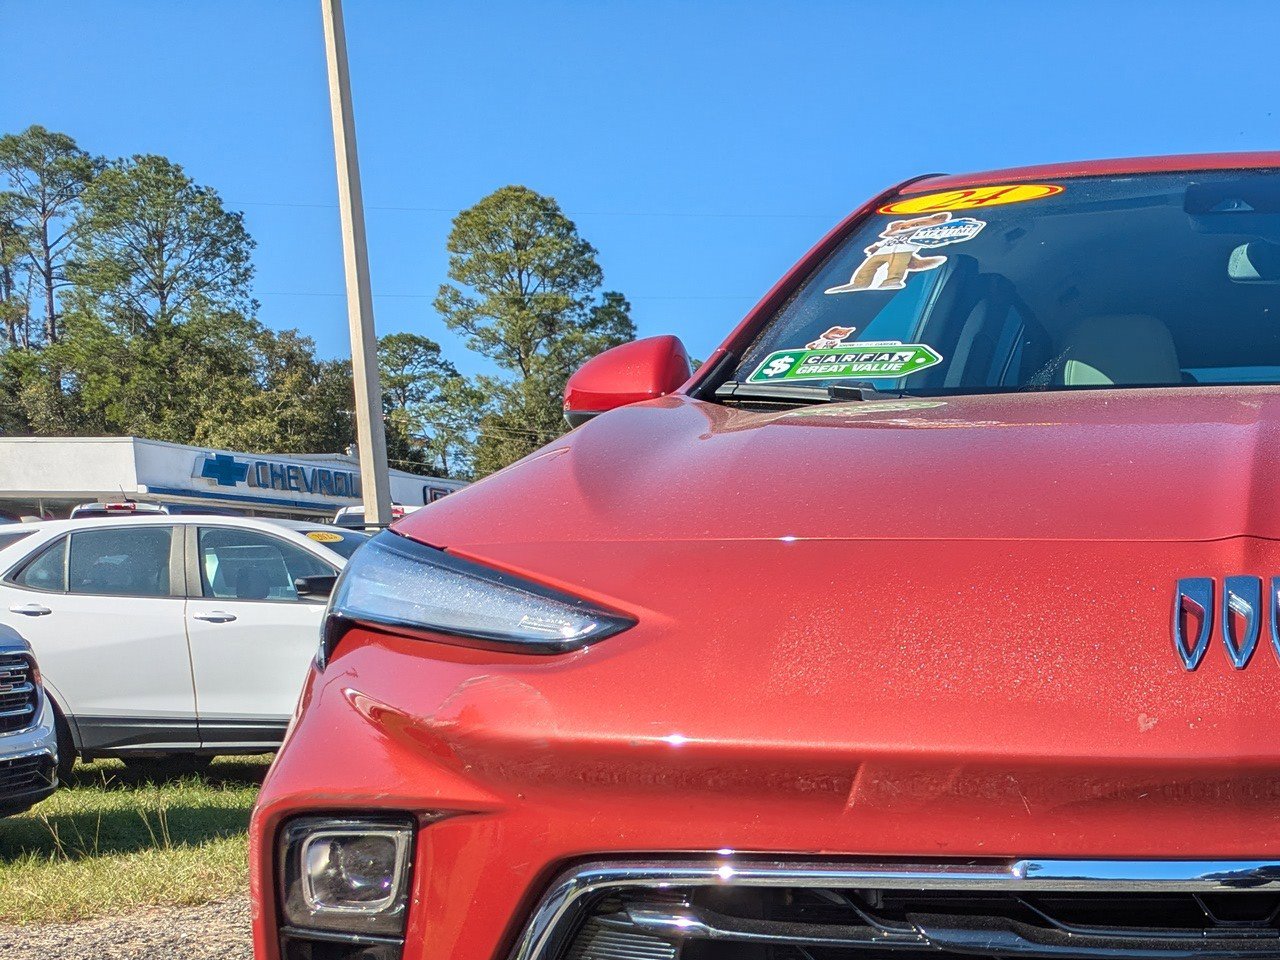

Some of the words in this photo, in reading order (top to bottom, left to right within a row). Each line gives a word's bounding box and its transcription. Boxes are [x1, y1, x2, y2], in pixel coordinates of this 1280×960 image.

[763, 355, 795, 377] $
[806, 352, 913, 364] CARFAX
[796, 364, 849, 375] GREAT
[851, 363, 904, 373] VALUE
[255, 461, 362, 499] CHEVROL
